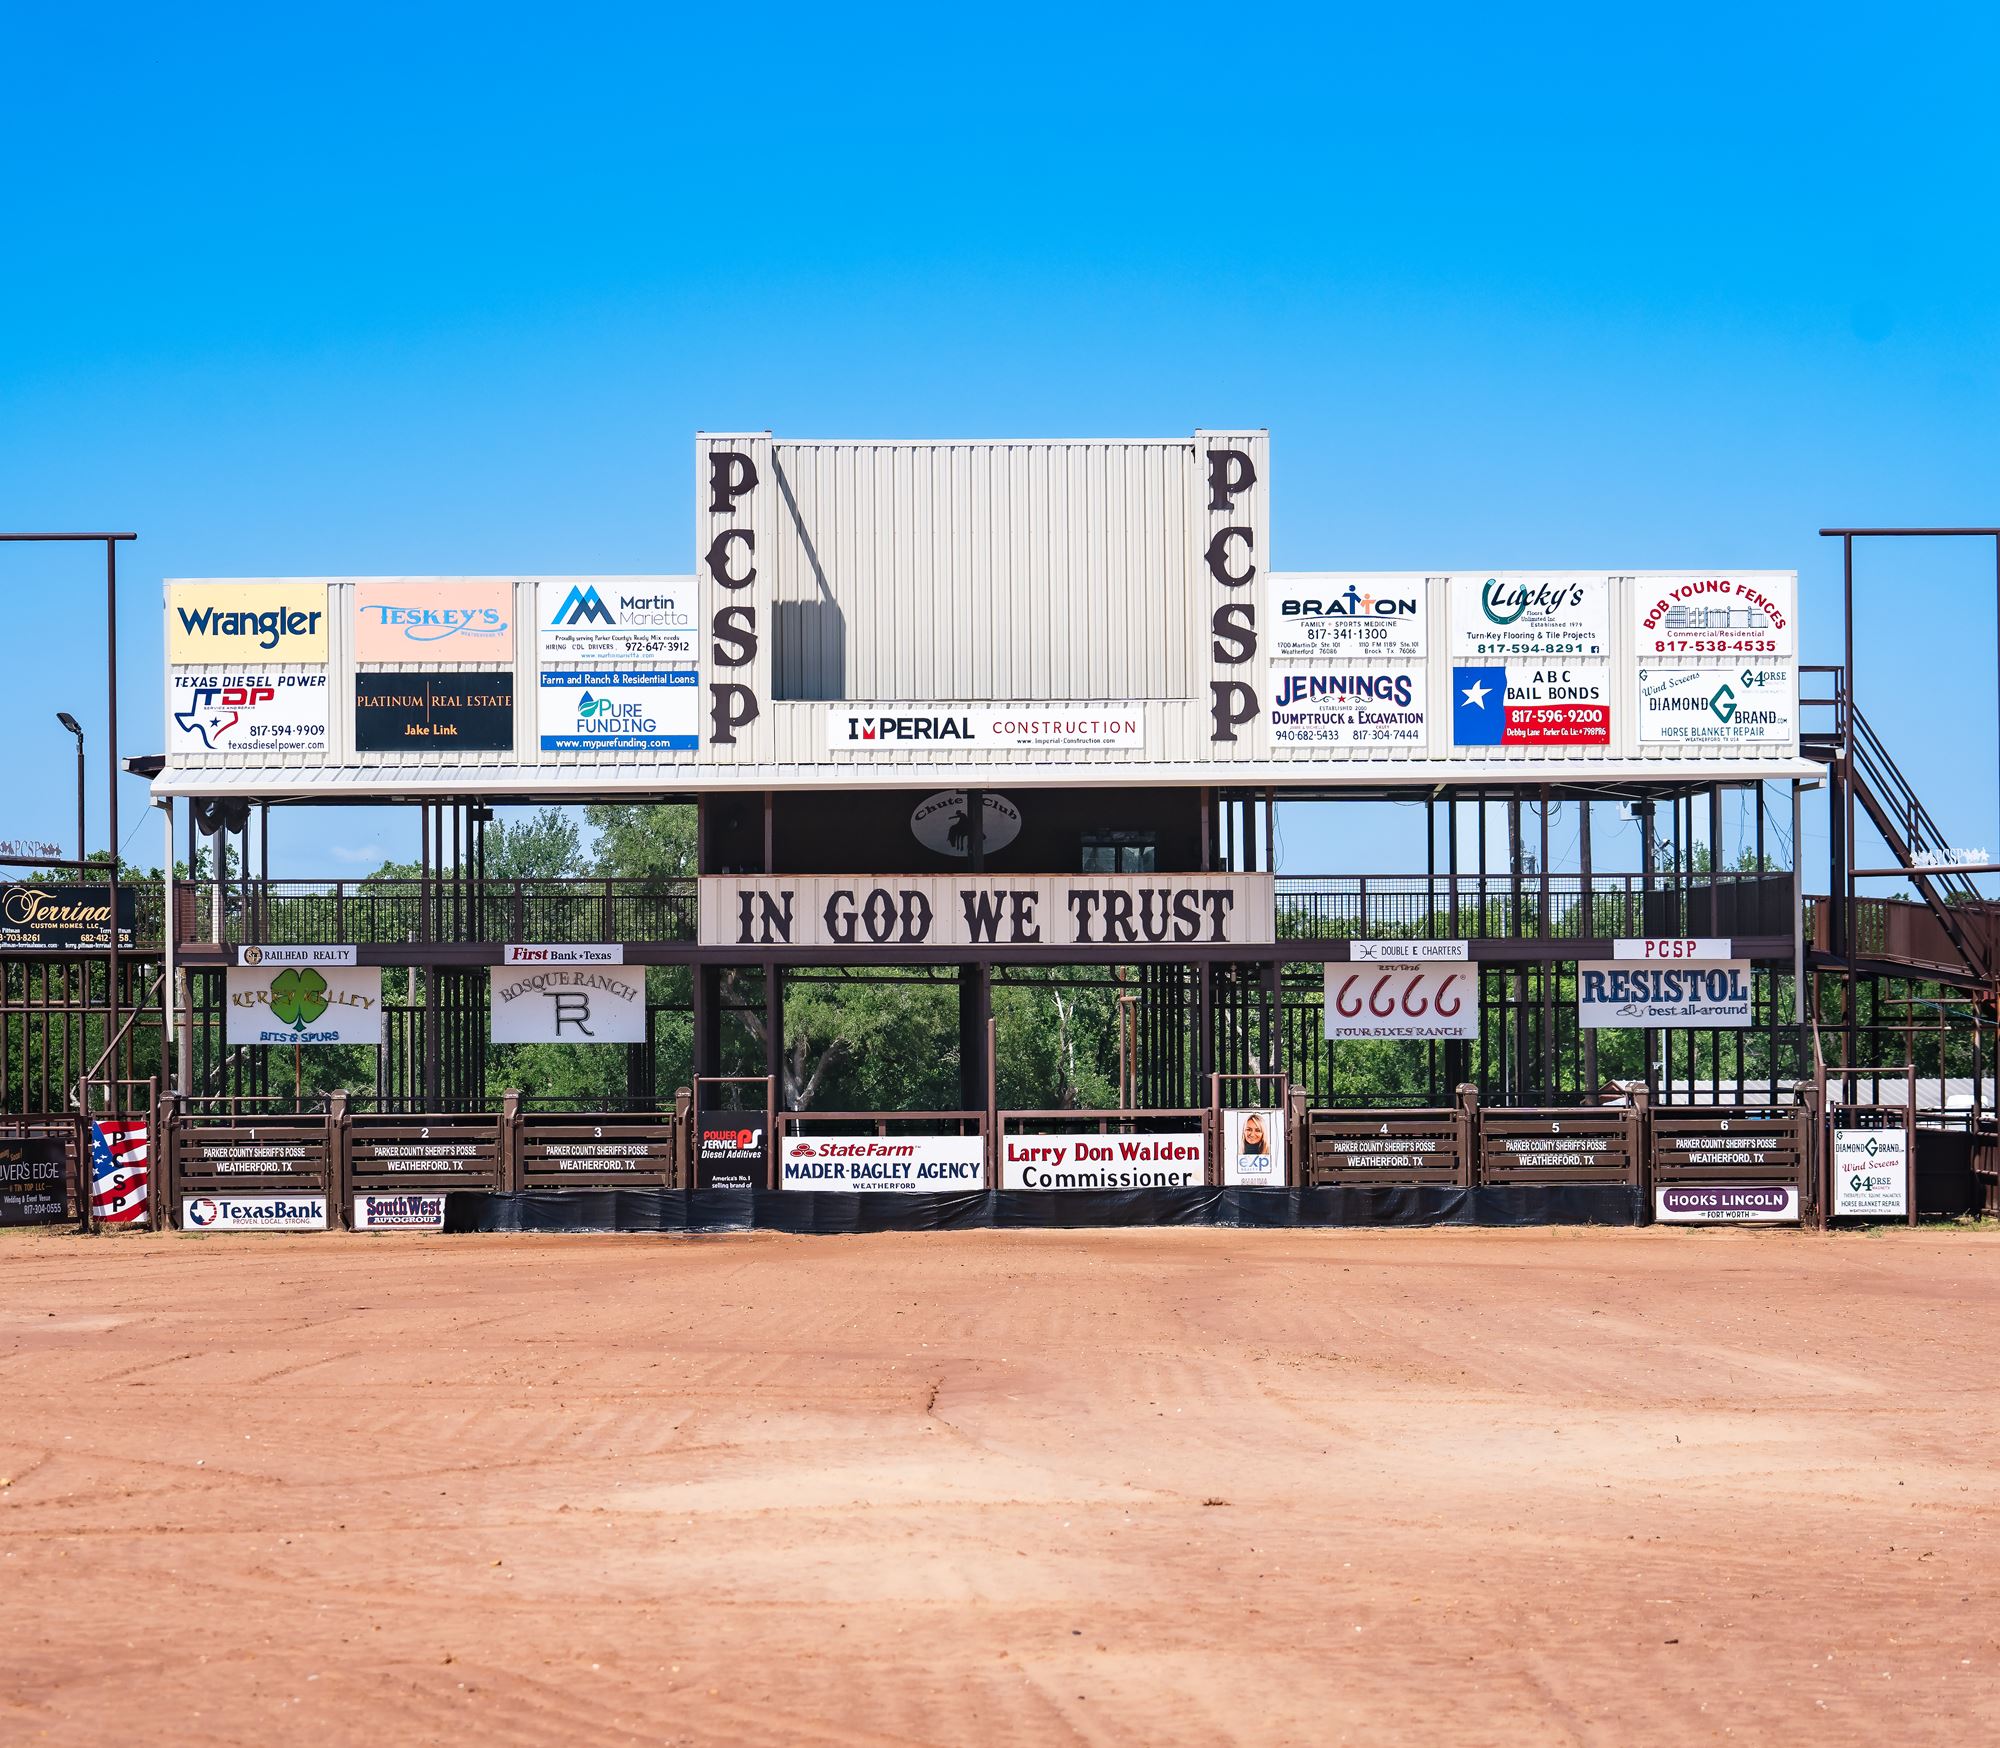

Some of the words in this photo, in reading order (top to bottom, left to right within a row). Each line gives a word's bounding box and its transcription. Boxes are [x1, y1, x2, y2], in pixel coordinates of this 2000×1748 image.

[620, 595, 674, 610] Martin
[1282, 592, 1417, 615] BRATTON
[1490, 583, 1584, 615] Lucky's
[1643, 600, 1670, 630] BOB
[1669, 580, 1731, 602] YOUNG
[1735, 584, 1787, 630] FENCES
[620, 611, 688, 628] Marietta
[177, 606, 322, 649] Wrangler
[1307, 628, 1388, 640] 817-341-1300
[1503, 632, 1535, 641] Flooring
[1562, 631, 1596, 641] Projects
[625, 641, 689, 652] 972-647-3912
[1477, 643, 1583, 654] 817-594-8291
[1655, 640, 1777, 652] 817-538-4535
[175, 676, 218, 688] TEXAS
[223, 676, 272, 688] DIESEL
[278, 675, 326, 687] POWER
[542, 675, 564, 685] Farm
[567, 674, 582, 685] and
[584, 675, 611, 685] Ranch
[613, 675, 620, 684] &
[622, 674, 667, 684] Residential
[669, 674, 696, 684] Loans
[1641, 682, 1667, 697] Wind
[1669, 671, 1700, 688] Screens
[196, 688, 275, 706] TDP
[1275, 675, 1413, 707] JENNINGS
[1507, 687, 1541, 700] BAIL
[1548, 687, 1600, 700] BONDS
[357, 695, 424, 707] PLATINUM
[431, 695, 463, 707] REAL
[467, 695, 512, 707] ESTATE
[1649, 697, 1709, 711] DIAMOND
[599, 698, 643, 718] PURE
[1272, 711, 1345, 725] DUMPTRUCK
[1348, 715, 1355, 724] &
[1358, 711, 1424, 725] EXCAVATION
[1511, 709, 1603, 723] 817-596-9200
[1735, 711, 1776, 724] BRAND
[250, 725, 325, 737] 817-594-9909
[404, 724, 430, 736] Jake
[433, 723, 458, 736] Link
[577, 718, 657, 733] FUNDING
[848, 717, 975, 740] IMPERIAL
[992, 720, 1137, 734] CONSTRUCTION
[1275, 730, 1340, 741] 940-682-5433
[1352, 729, 1419, 741] 817-304-7444
[1506, 727, 1526, 739] Debby
[1527, 727, 1540, 736] Lane
[1661, 727, 1688, 737] HORSE
[1691, 727, 1731, 737] BLANKET
[1733, 727, 1765, 737] REPAIR
[228, 739, 325, 752] texasdieselpower.com
[556, 738, 671, 750] www.mypurefunding.com
[914, 796, 964, 822] Chute
[982, 797, 1018, 821] Club
[2, 887, 112, 924] Terrina
[736, 889, 794, 943] IN
[823, 888, 934, 943] GOD
[960, 889, 1044, 943] WE
[1067, 888, 1235, 943] TRUST
[264, 951, 308, 960] RAILHEAD
[313, 950, 350, 960] REALTY
[512, 947, 549, 961] First
[550, 951, 578, 960] Bank
[583, 951, 612, 960] Texas
[1381, 946, 1409, 956] DOUBLE
[1412, 946, 1418, 956] E
[1421, 946, 1462, 956] CHARTERS
[1645, 940, 1697, 959] PCSP
[499, 971, 570, 1004] BOSQUE
[573, 972, 638, 1003] RANCH
[1582, 969, 1748, 1004] RESISTOL
[1335, 974, 1461, 1018] 6666
[259, 1031, 286, 1042] BITS
[301, 1031, 340, 1043] SPURS
[1335, 1027, 1372, 1038] FOUR
[1374, 1027, 1414, 1037] SIXES
[1415, 1027, 1464, 1037] RANCH
[1380, 1123, 1388, 1134] 4
[1552, 1122, 1560, 1133] 5
[1720, 1120, 1729, 1131] 6
[249, 1128, 255, 1140] 1
[421, 1127, 429, 1139] 2
[594, 1127, 602, 1138] 3
[703, 1130, 737, 1140] POWER
[702, 1140, 737, 1150] SERVICE
[1676, 1139, 1700, 1149] PARKER
[1701, 1139, 1725, 1149] COUNTY
[1725, 1139, 1756, 1149] SHERIFF'S
[1757, 1139, 1776, 1149] POSSE
[1835, 1143, 1864, 1153] DIAMOND
[203, 1147, 228, 1158] PARKER
[228, 1147, 254, 1158] COUNTY
[254, 1147, 284, 1158] SHERIFF'S
[285, 1147, 306, 1158] POSSE
[701, 1150, 725, 1159] Diesel
[726, 1149, 762, 1159] Additives
[1008, 1143, 1067, 1166] Larry
[1074, 1142, 1114, 1162] Don
[1118, 1142, 1200, 1162] Walden
[1753, 1153, 1765, 1162] TX
[32, 1162, 60, 1179] EDGE
[281, 1162, 293, 1171] TX
[785, 1163, 912, 1179] MADER-BAGLEY
[917, 1162, 981, 1179] AGENCY
[1841, 1162, 1866, 1173] Wind
[1868, 1159, 1899, 1169] Screens
[1022, 1166, 1193, 1188] Commissioner
[852, 1182, 916, 1190] WEATHERFORD
[1669, 1194, 1718, 1206] HOOKS
[1721, 1194, 1784, 1206] LINCOLN
[219, 1200, 323, 1219] TexasBank
[1707, 1211, 1724, 1219] FORT
